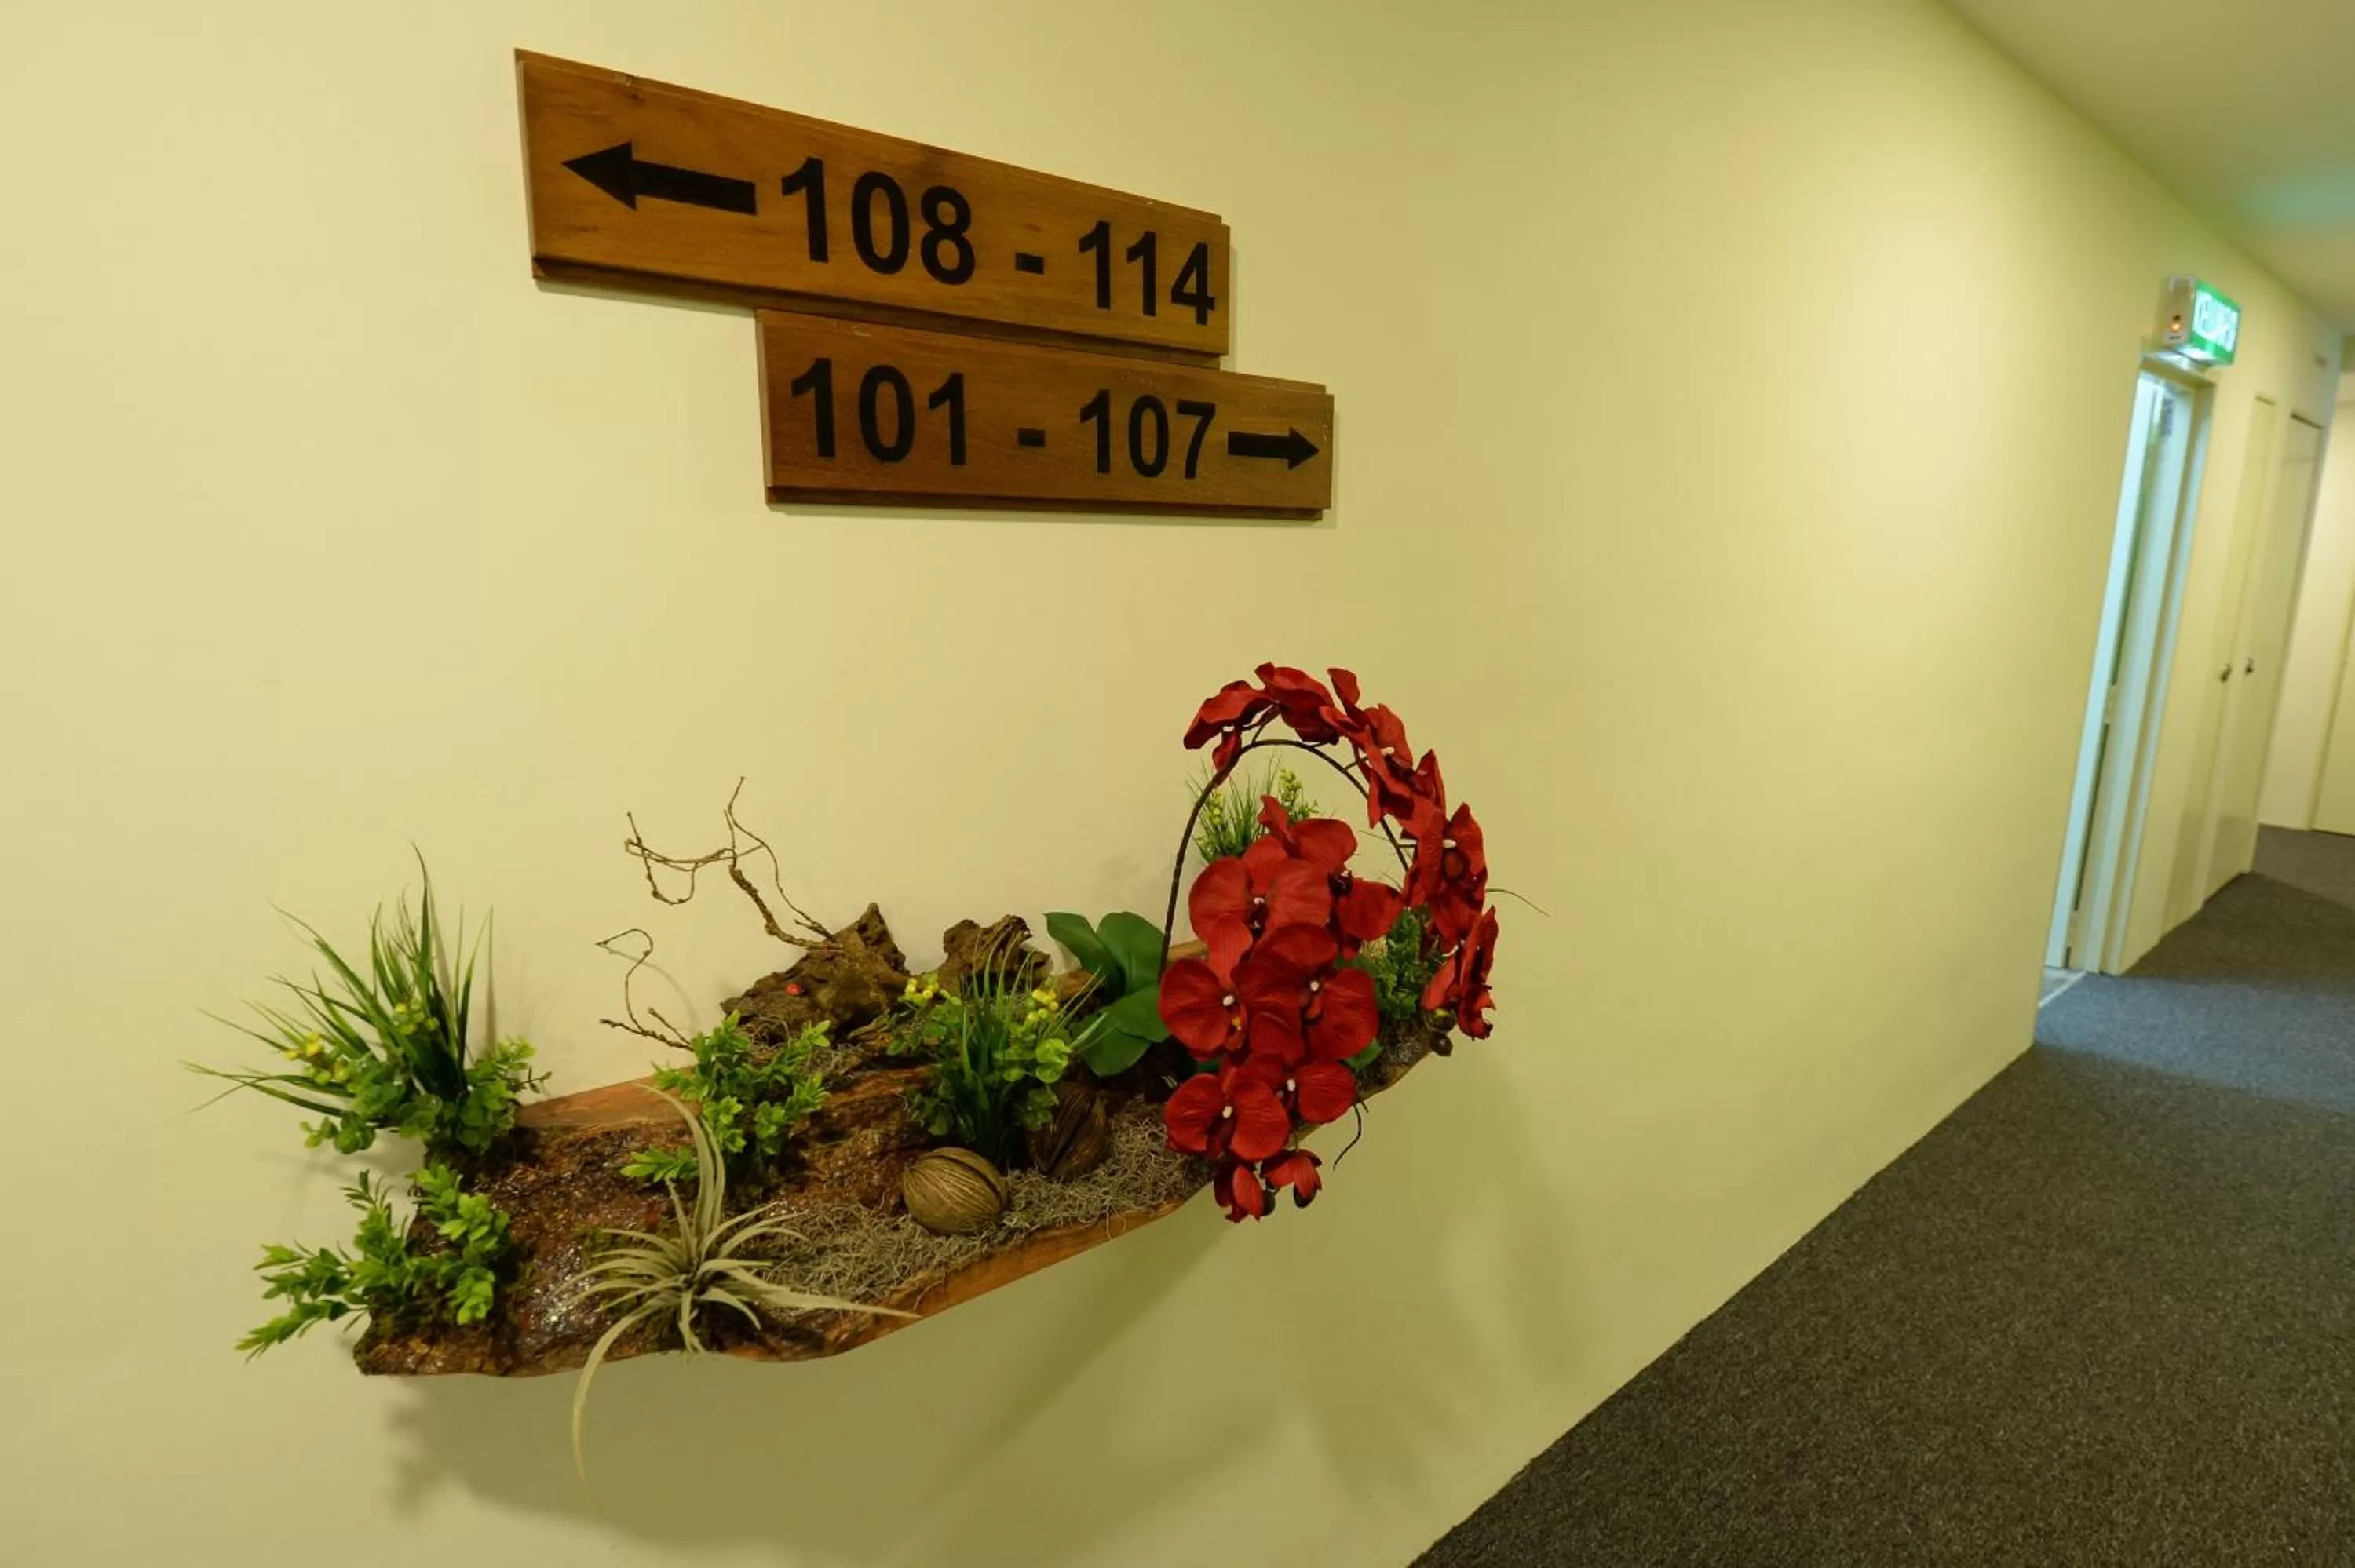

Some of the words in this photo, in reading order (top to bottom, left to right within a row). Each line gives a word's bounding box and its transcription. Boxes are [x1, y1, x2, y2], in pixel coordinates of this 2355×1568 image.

[781, 156, 977, 286] 108
[1014, 252, 1046, 275] -
[1078, 219, 1216, 326] 114
[790, 357, 968, 467] 101
[1017, 428, 1046, 450] -
[1079, 388, 1217, 480] 107
